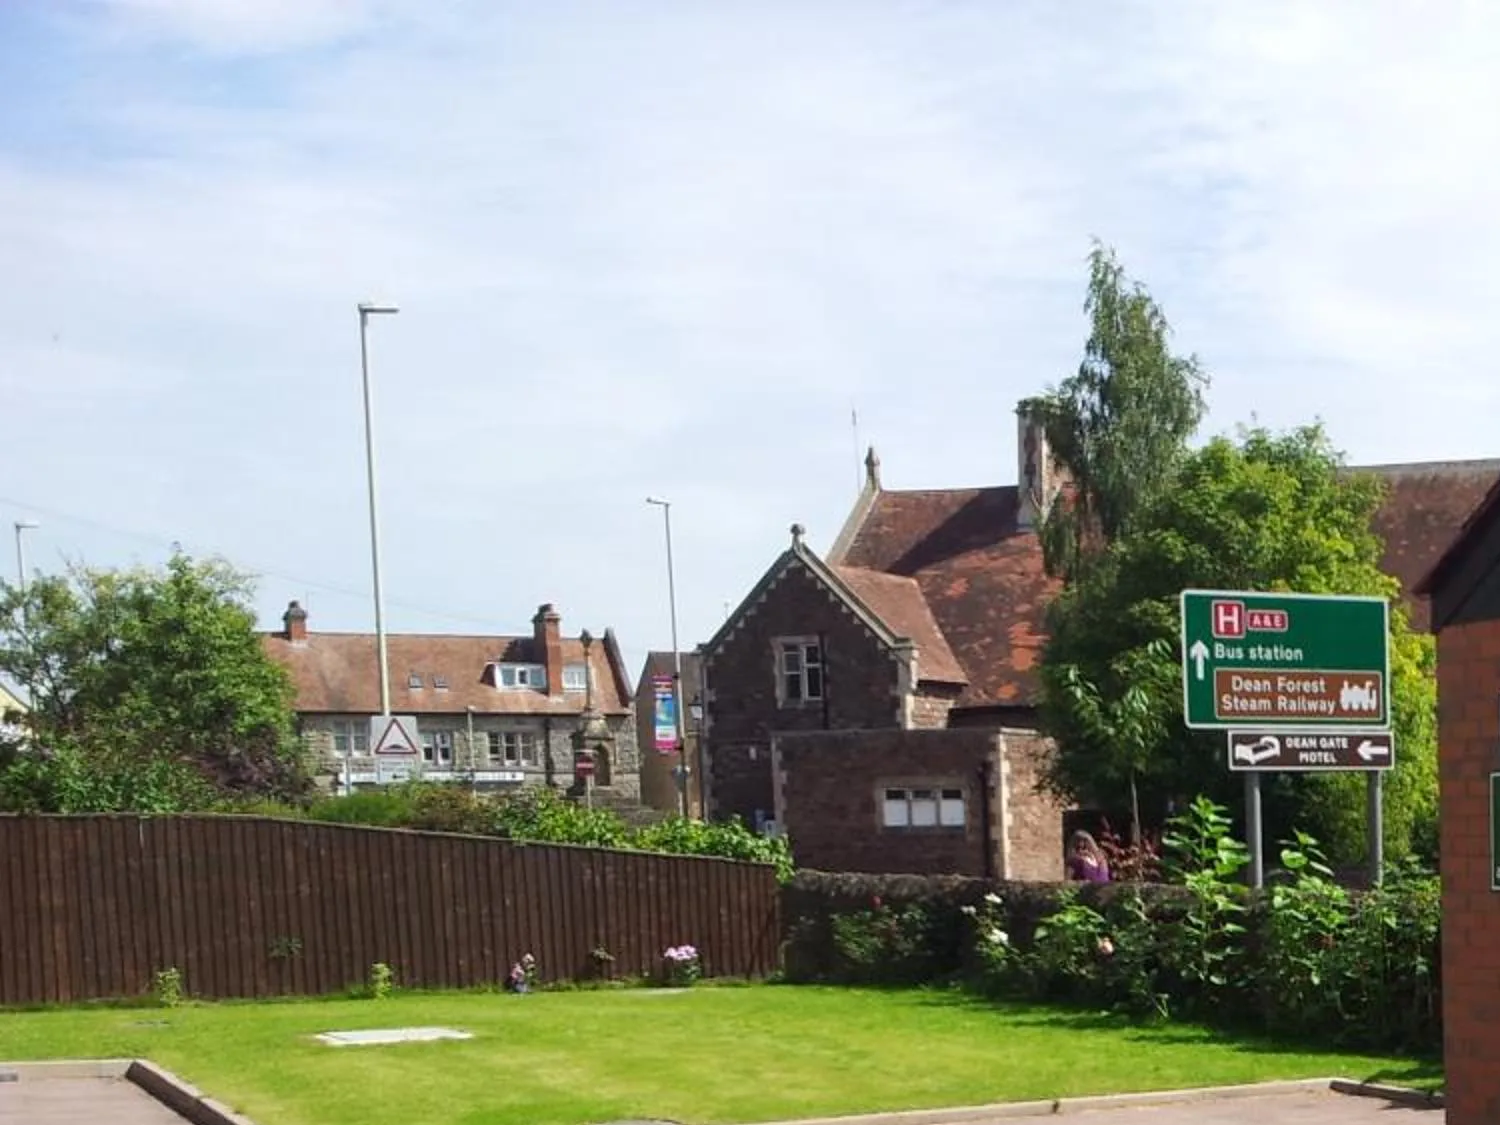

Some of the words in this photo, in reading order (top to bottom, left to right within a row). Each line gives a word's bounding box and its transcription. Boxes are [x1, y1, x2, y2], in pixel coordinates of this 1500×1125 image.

[1217, 605, 1239, 633] H
[1214, 643, 1244, 659] Bus
[1249, 645, 1304, 661] station
[1231, 675, 1271, 692] Dean
[1277, 676, 1326, 693] Forest
[1222, 694, 1272, 711] Steam
[1277, 696, 1336, 715] Railway
[1285, 737, 1317, 749] DEAN
[1319, 737, 1348, 749] GATE
[1299, 751, 1337, 763] MOTEL
